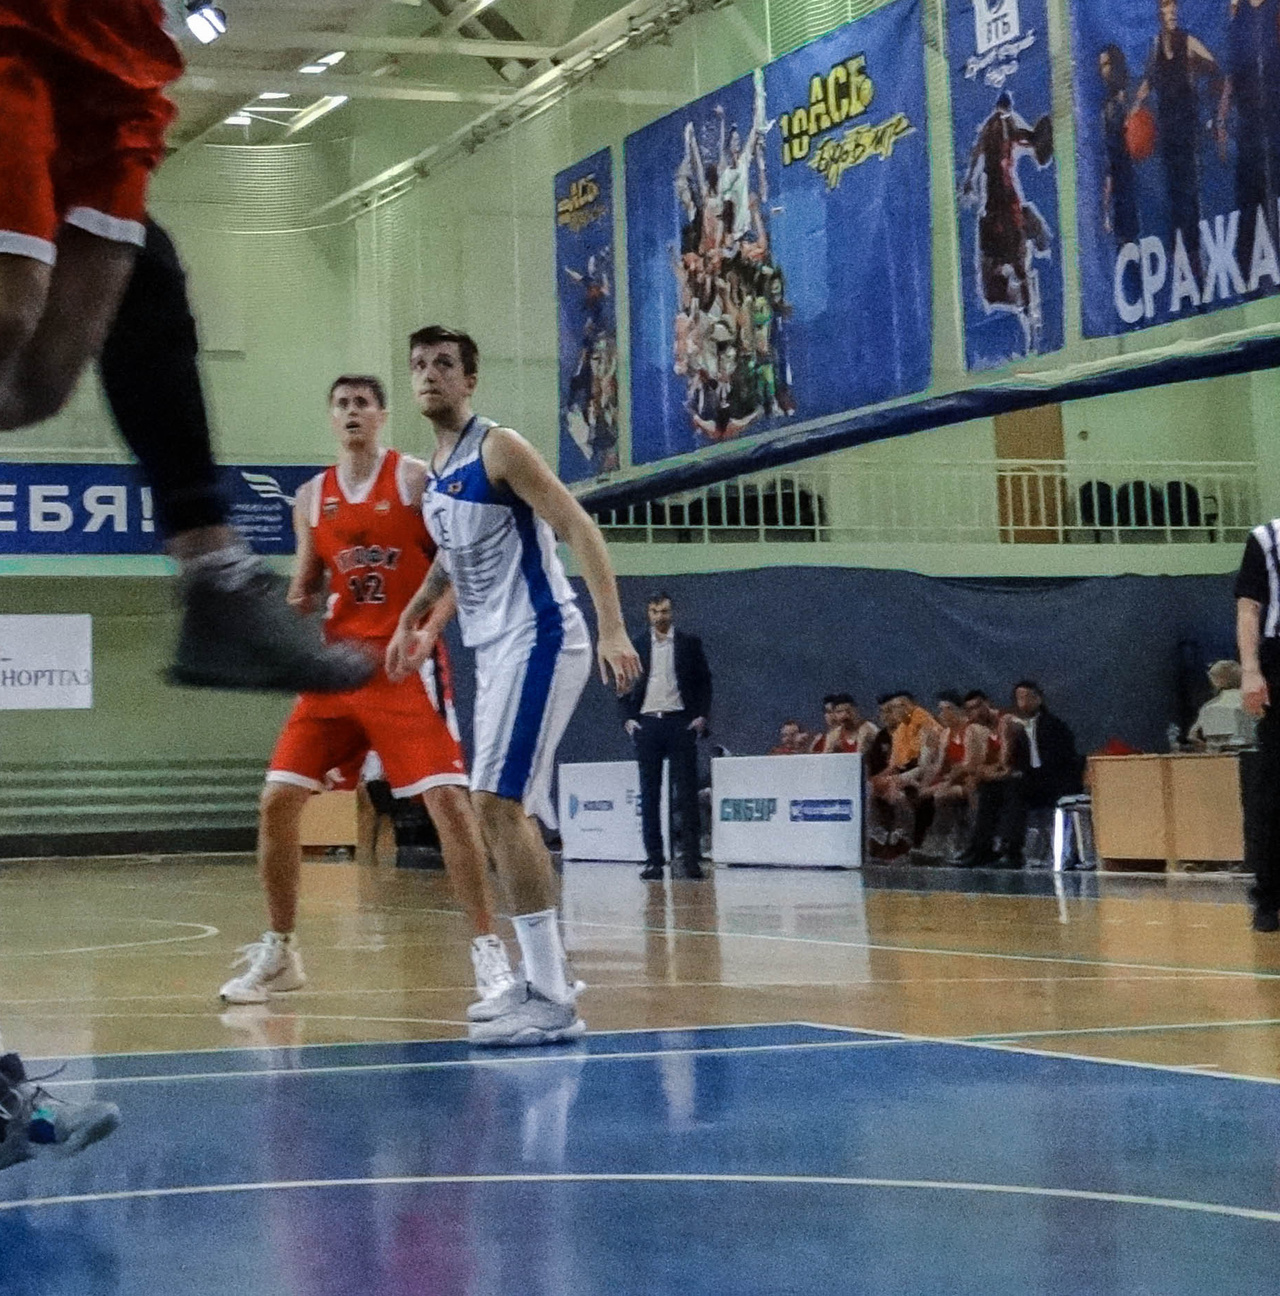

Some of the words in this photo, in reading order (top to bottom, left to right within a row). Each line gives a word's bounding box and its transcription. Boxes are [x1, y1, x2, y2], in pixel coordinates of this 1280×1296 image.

[807, 52, 874, 138] АСБ
[1113, 195, 1280, 325] СРАЖА
[347, 571, 387, 605] 12
